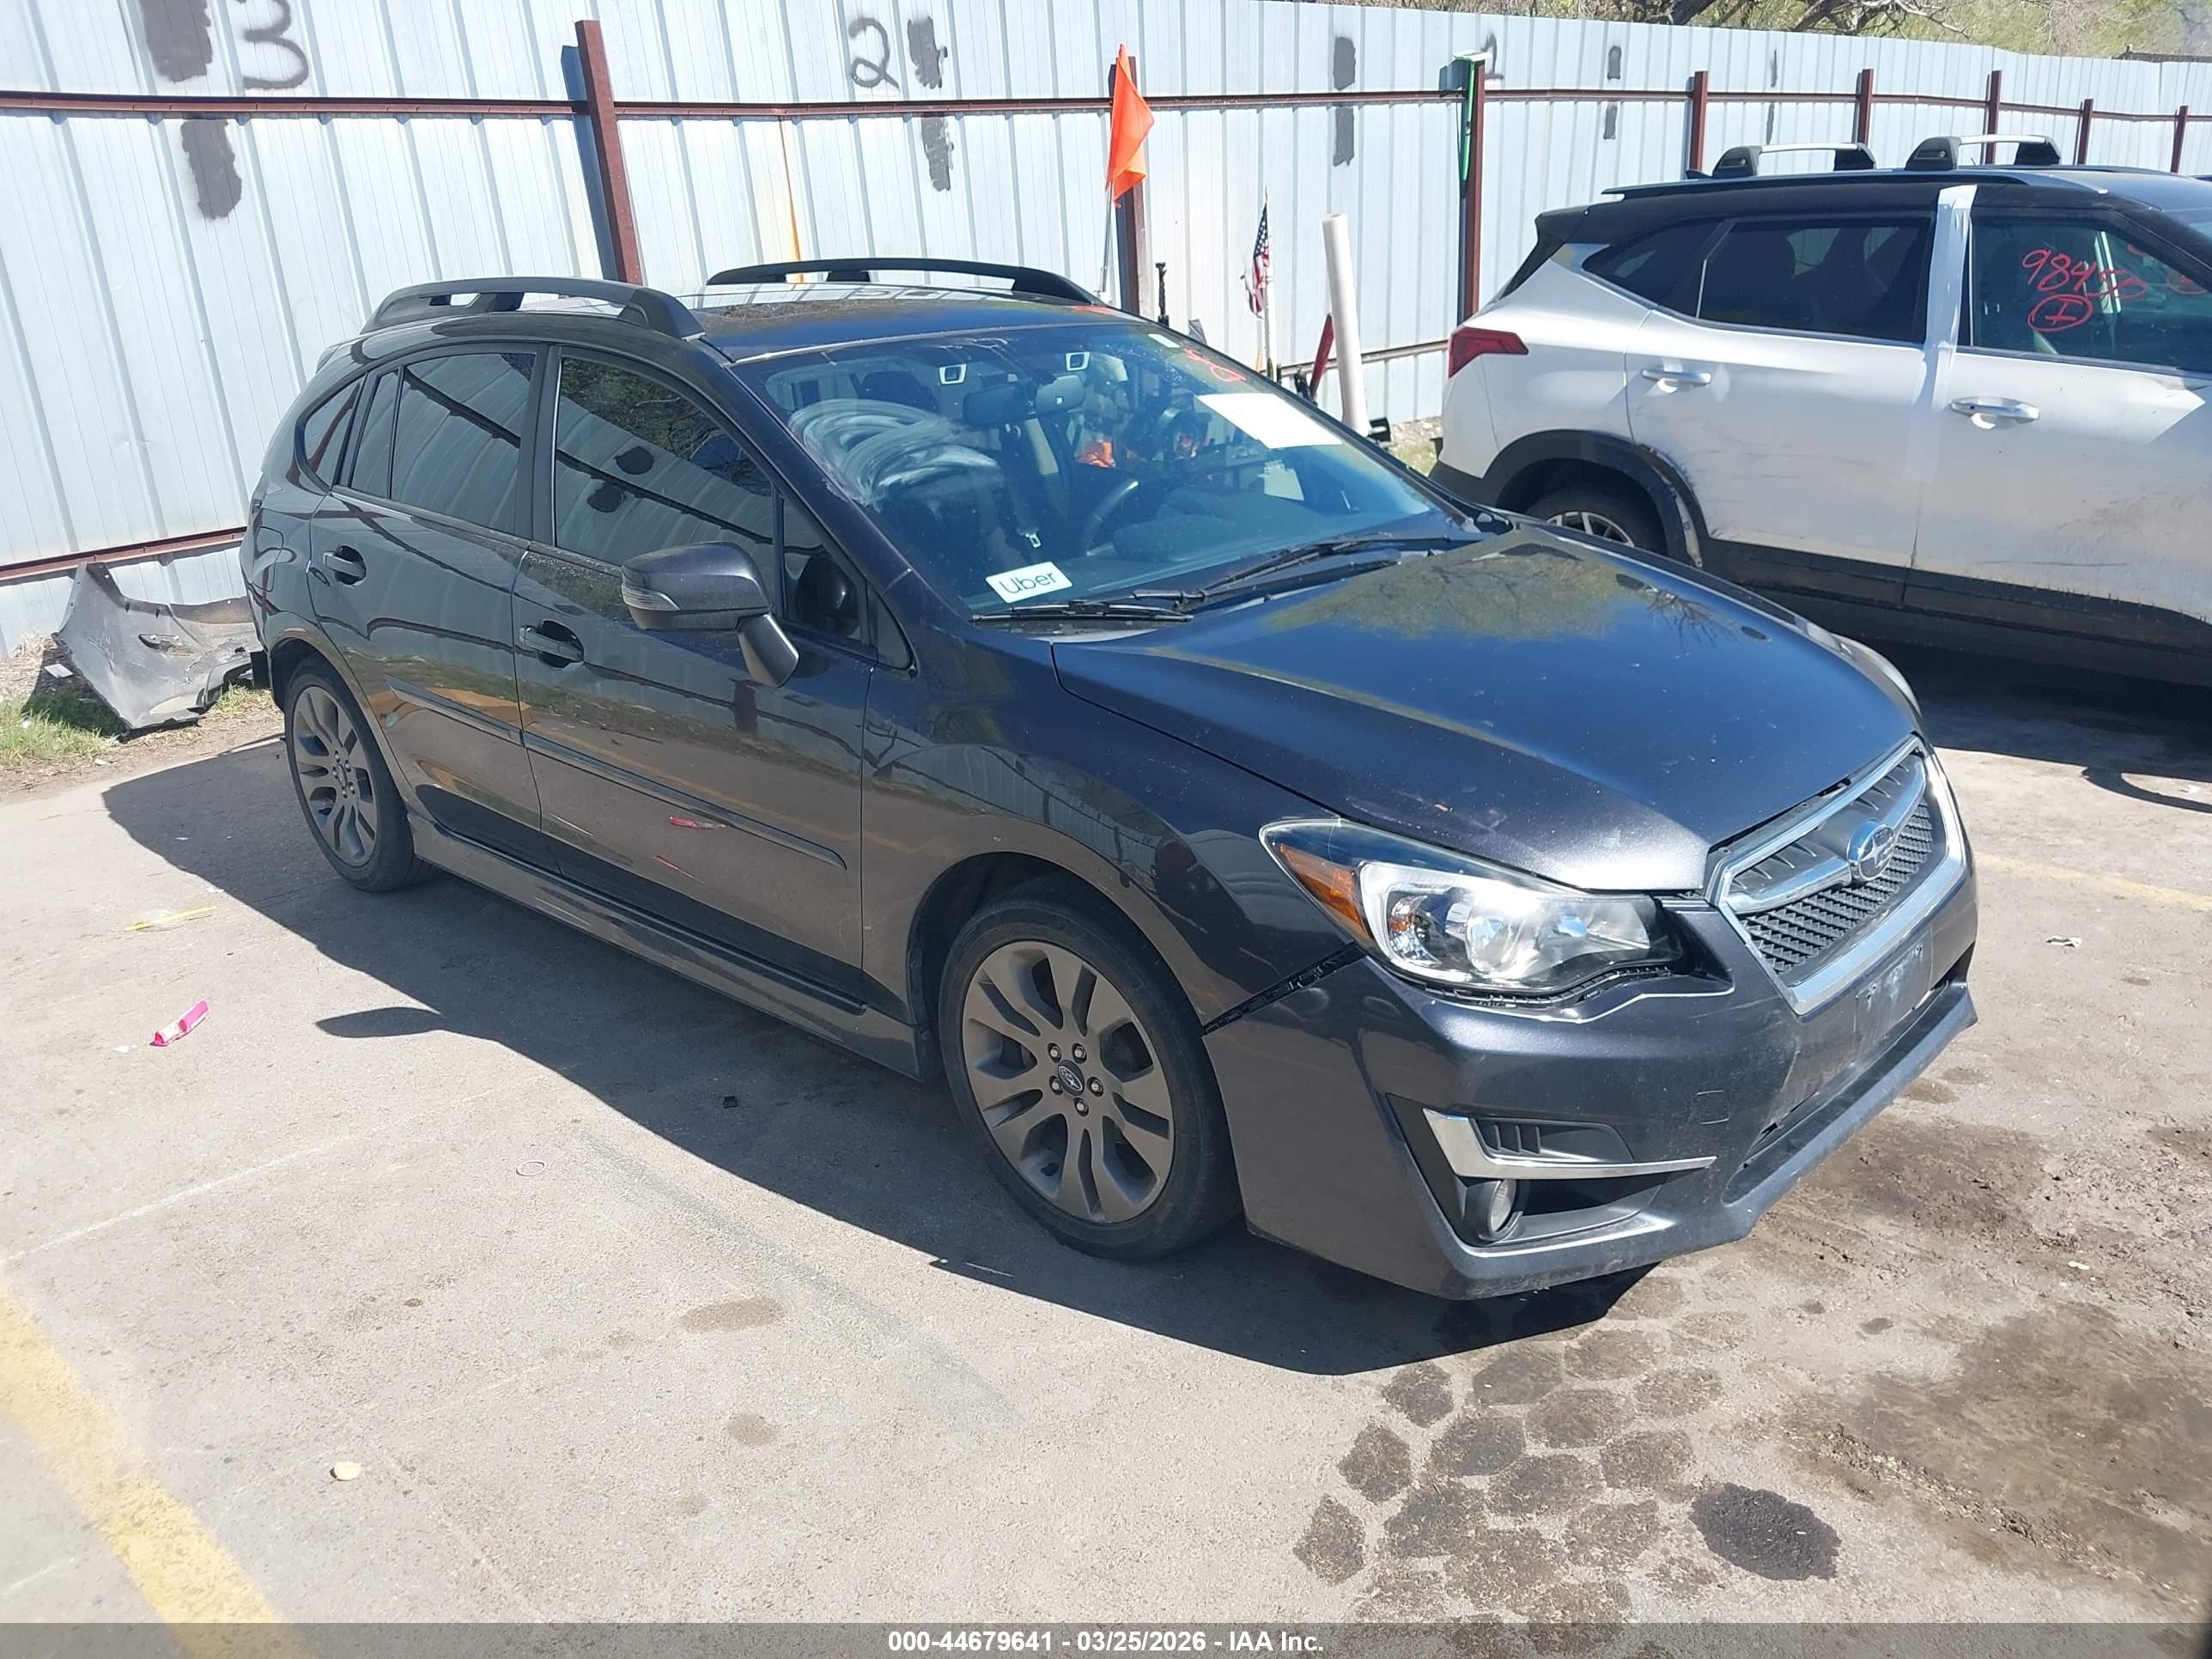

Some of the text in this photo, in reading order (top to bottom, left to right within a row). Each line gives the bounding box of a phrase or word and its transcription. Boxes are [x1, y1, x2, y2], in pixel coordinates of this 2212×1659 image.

[234, 0, 309, 89] 3
[848, 16, 901, 91] 2
[998, 572, 1056, 593] Uber
